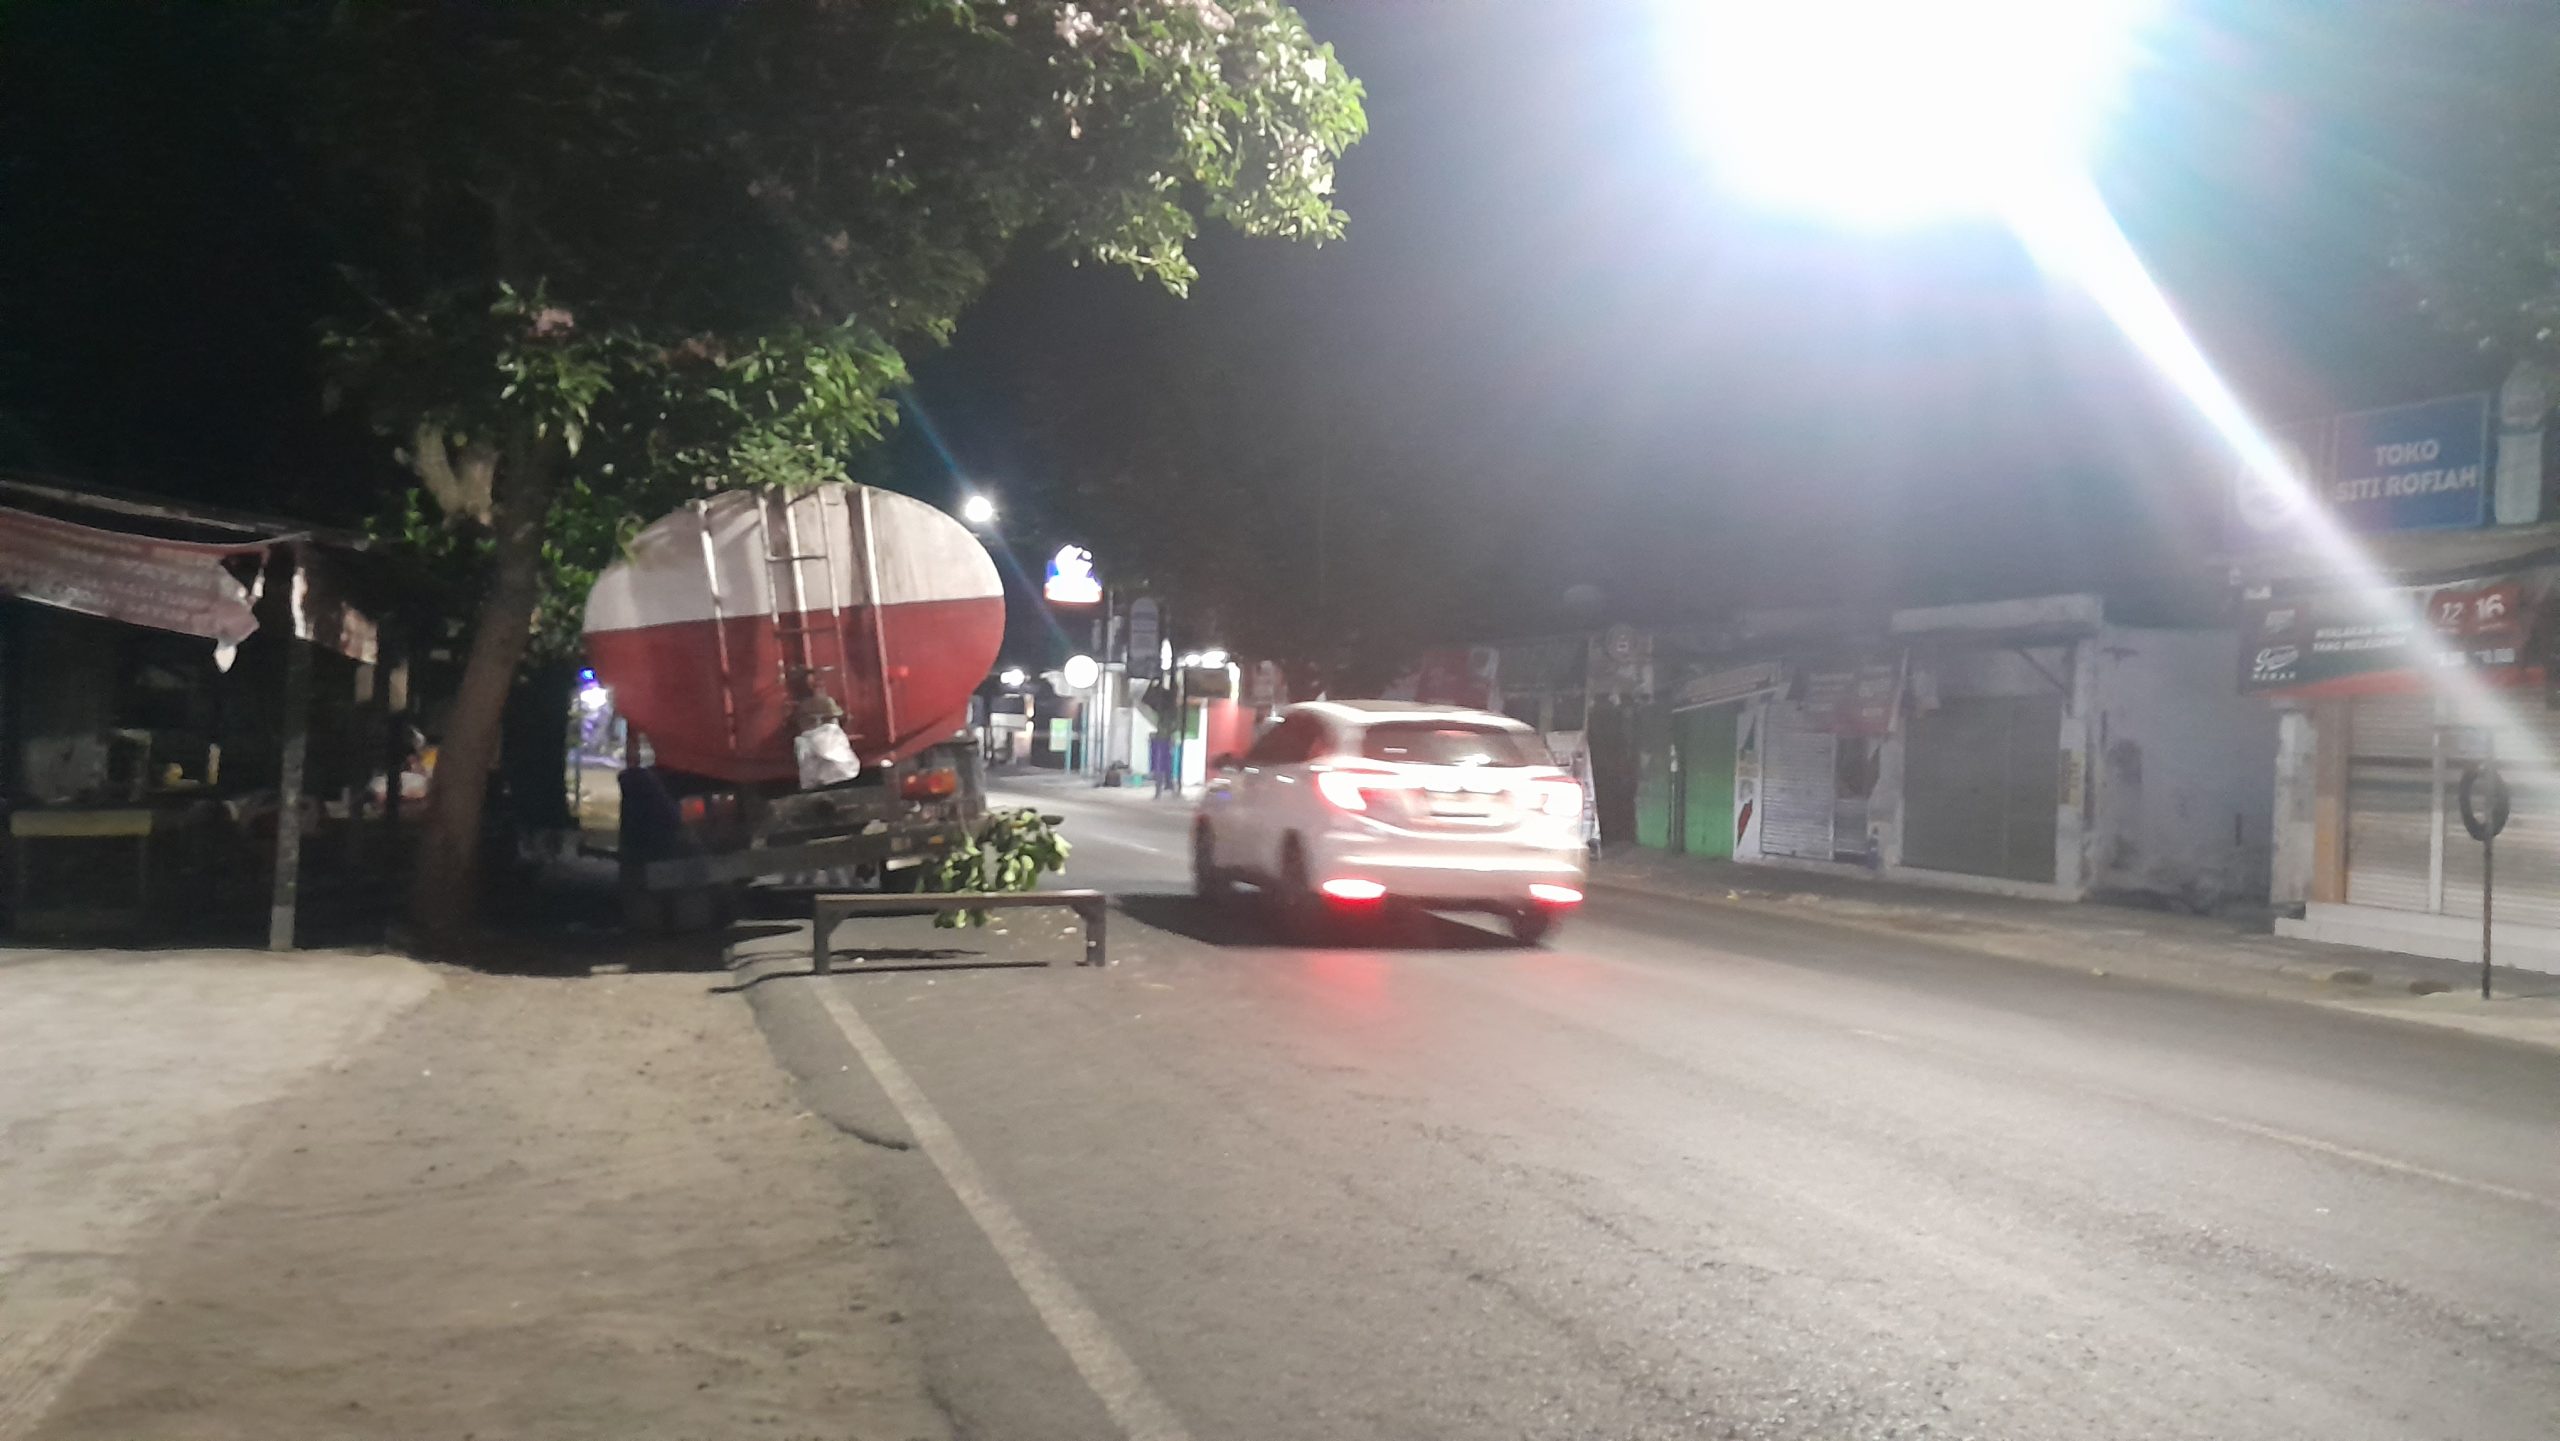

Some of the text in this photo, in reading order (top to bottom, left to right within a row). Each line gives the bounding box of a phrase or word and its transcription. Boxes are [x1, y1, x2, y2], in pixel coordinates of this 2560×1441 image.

[2376, 439, 2439, 466] TOKO
[2336, 466, 2477, 502] SITI ROFIAH
[2442, 602, 2465, 625] 12
[2475, 593, 2506, 620] 16
